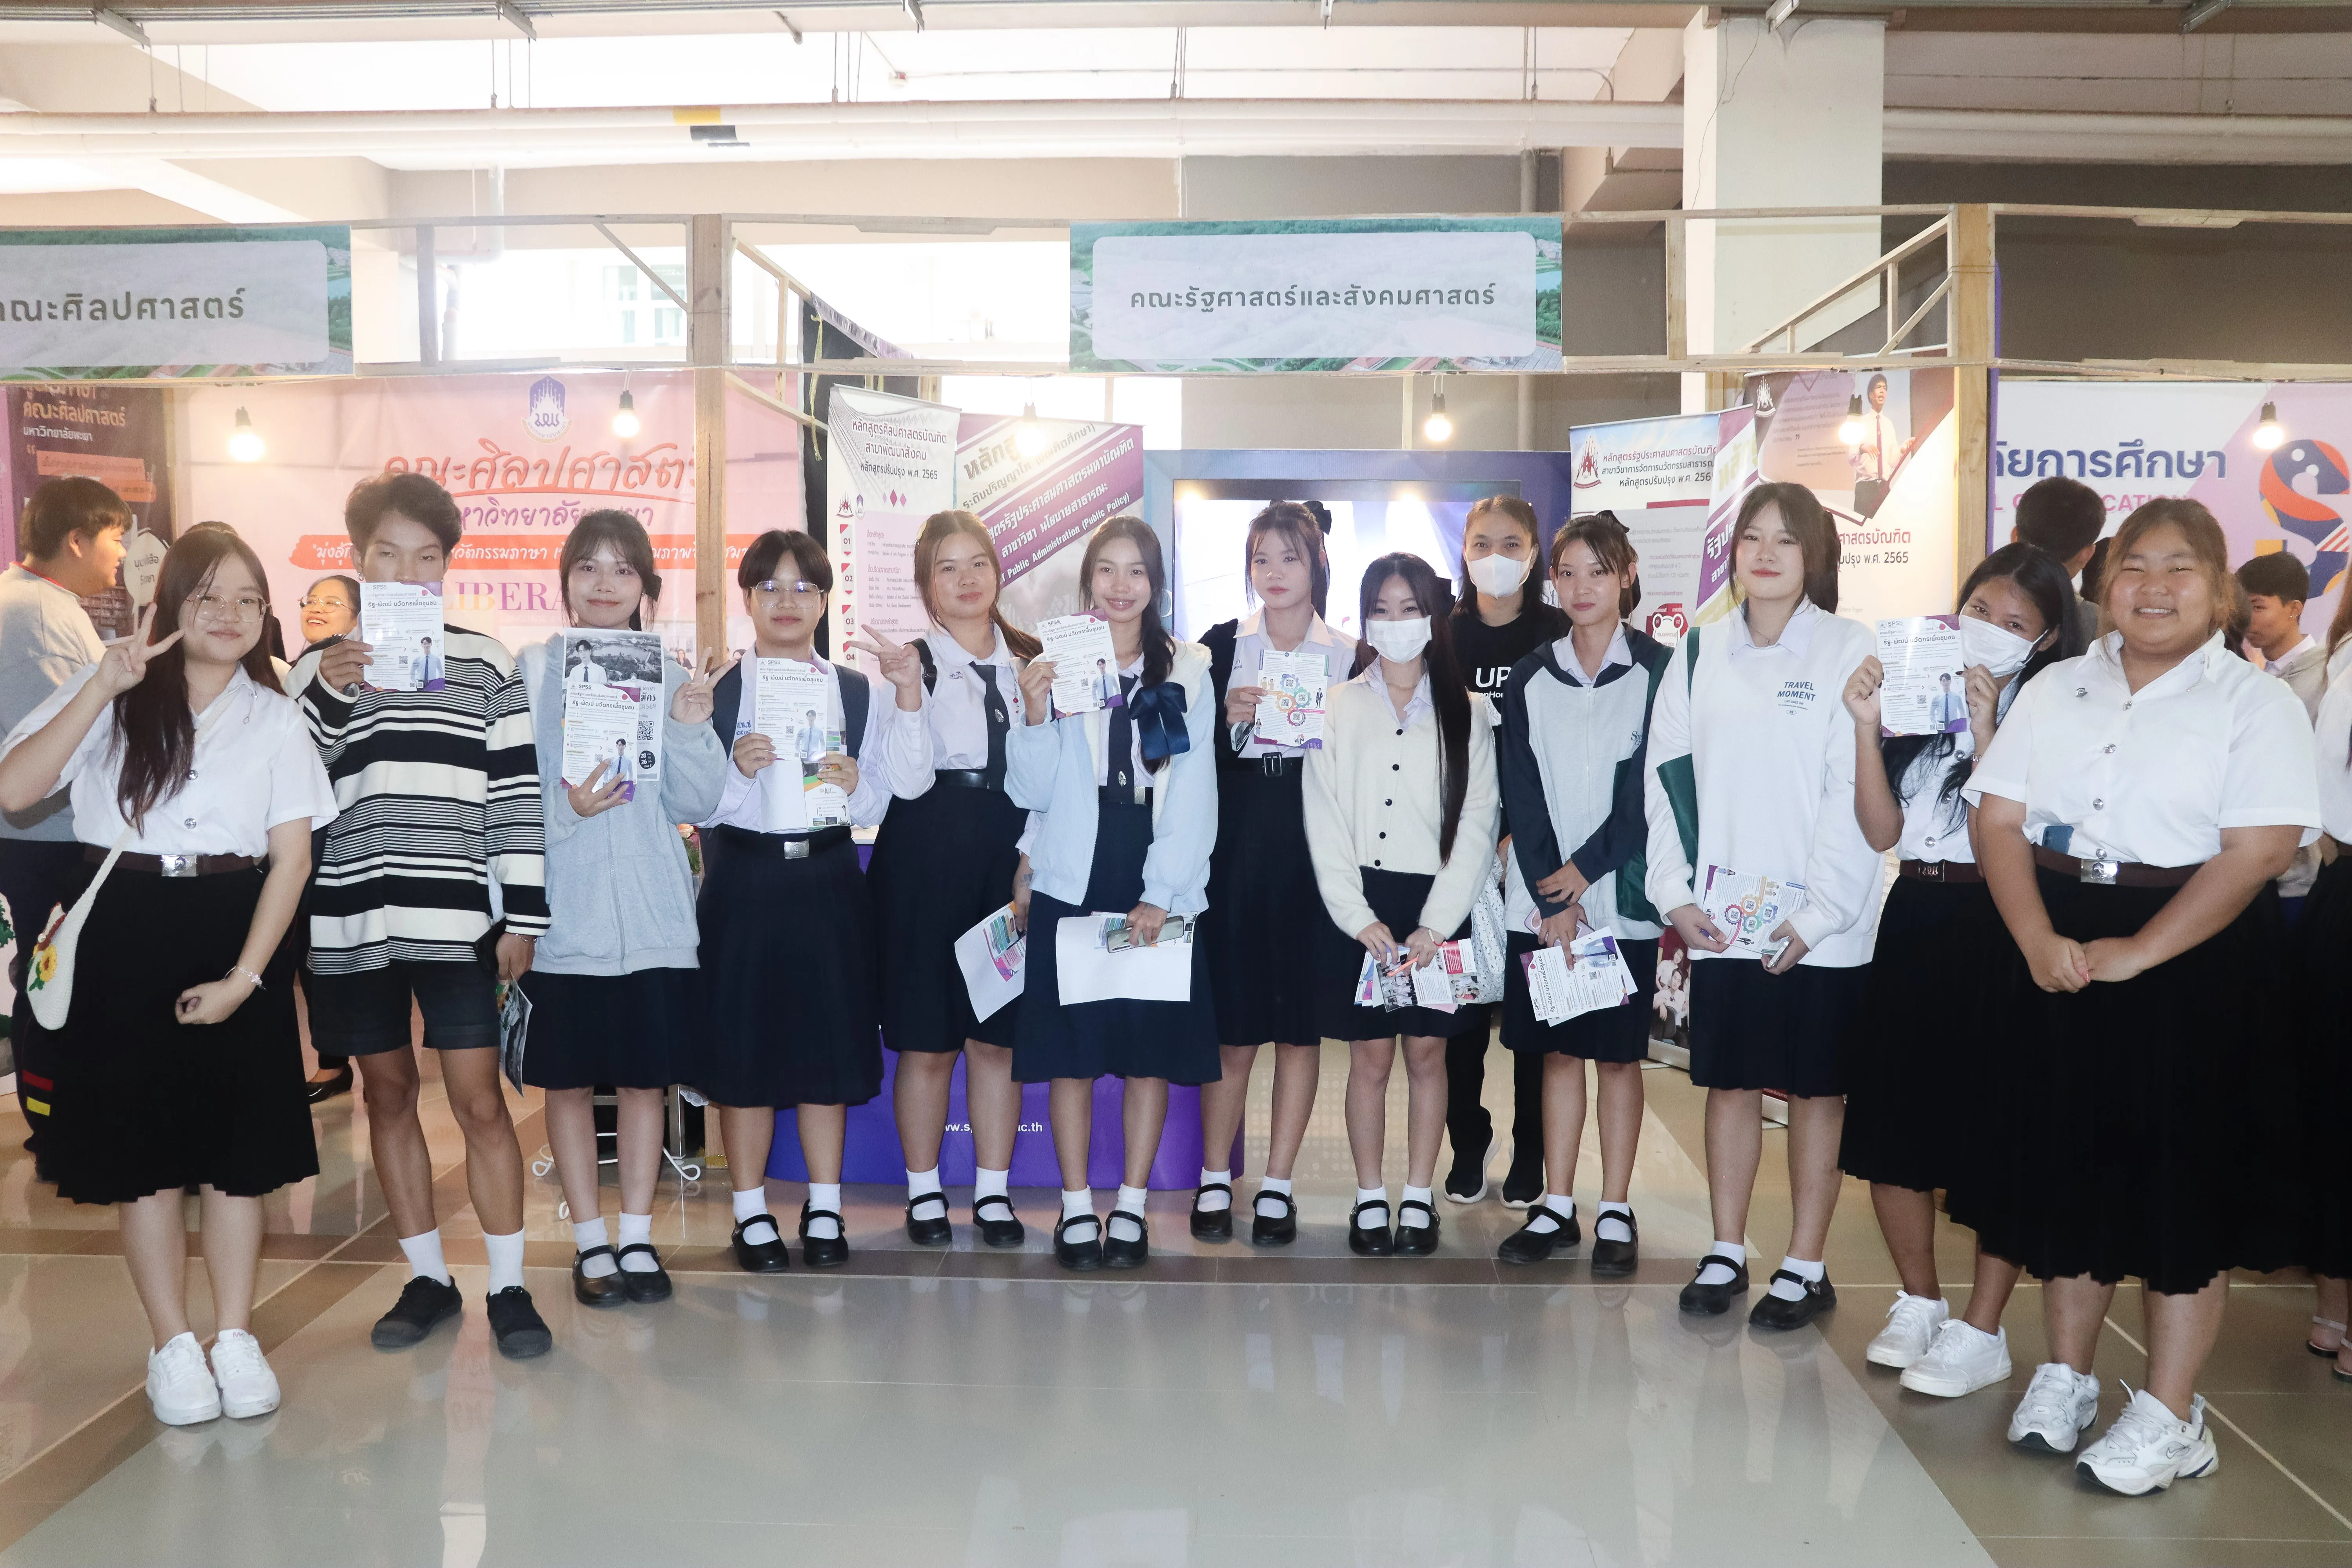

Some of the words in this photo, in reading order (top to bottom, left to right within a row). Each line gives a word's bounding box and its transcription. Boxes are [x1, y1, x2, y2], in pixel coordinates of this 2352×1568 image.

[1131, 283, 1496, 312] คณะรัฐศาสตร์และสังคมศาสตร์
[23, 401, 126, 426] คณะศิลปศาสตร์
[23, 426, 93, 441] มหาวิทยาลัยพะเยา
[853, 419, 947, 444] หลักสูตรศิลปศาสตรบัณฑิต
[866, 443, 926, 461] สาขาพัฒนาสังคม
[385, 438, 694, 491] คณะศิลปศาสต
[860, 461, 905, 479] หลักสูตรปรับปรุง
[907, 470, 920, 478] พ.ศ.
[922, 469, 938, 479] 2565
[1602, 459, 1714, 475] สาขาวิชาการจัดการนวัตกรรมสาธารณ
[1619, 475, 1675, 490] หลักสูตรปรับปรุง
[1695, 472, 1712, 482] 256
[989, 437, 1134, 544] สูตรรัฐประศาสนศาสตรมหาบัณฑิต
[1002, 528, 1038, 558] สาขาวิชา
[1040, 483, 1109, 533] นโยบายสาธารณะ
[1007, 559, 1030, 579] Public
[1032, 526, 1080, 563] Administration
[1082, 509, 1105, 531] (Public
[1106, 492, 1130, 513] Policy)
[1838, 528, 1911, 545] ศาสตรบัณฑิต
[1839, 552, 1861, 568] บปรุง
[1864, 554, 1880, 563] พ.ศ.
[1884, 552, 1909, 563] 2565
[444, 582, 564, 610] IBER
[1476, 666, 1512, 688] UP
[1784, 682, 1814, 690] TRAVEL
[641, 692, 656, 701] มัคร
[1777, 691, 1816, 701] MOMENT
[1017, 1122, 1043, 1132] c.th
